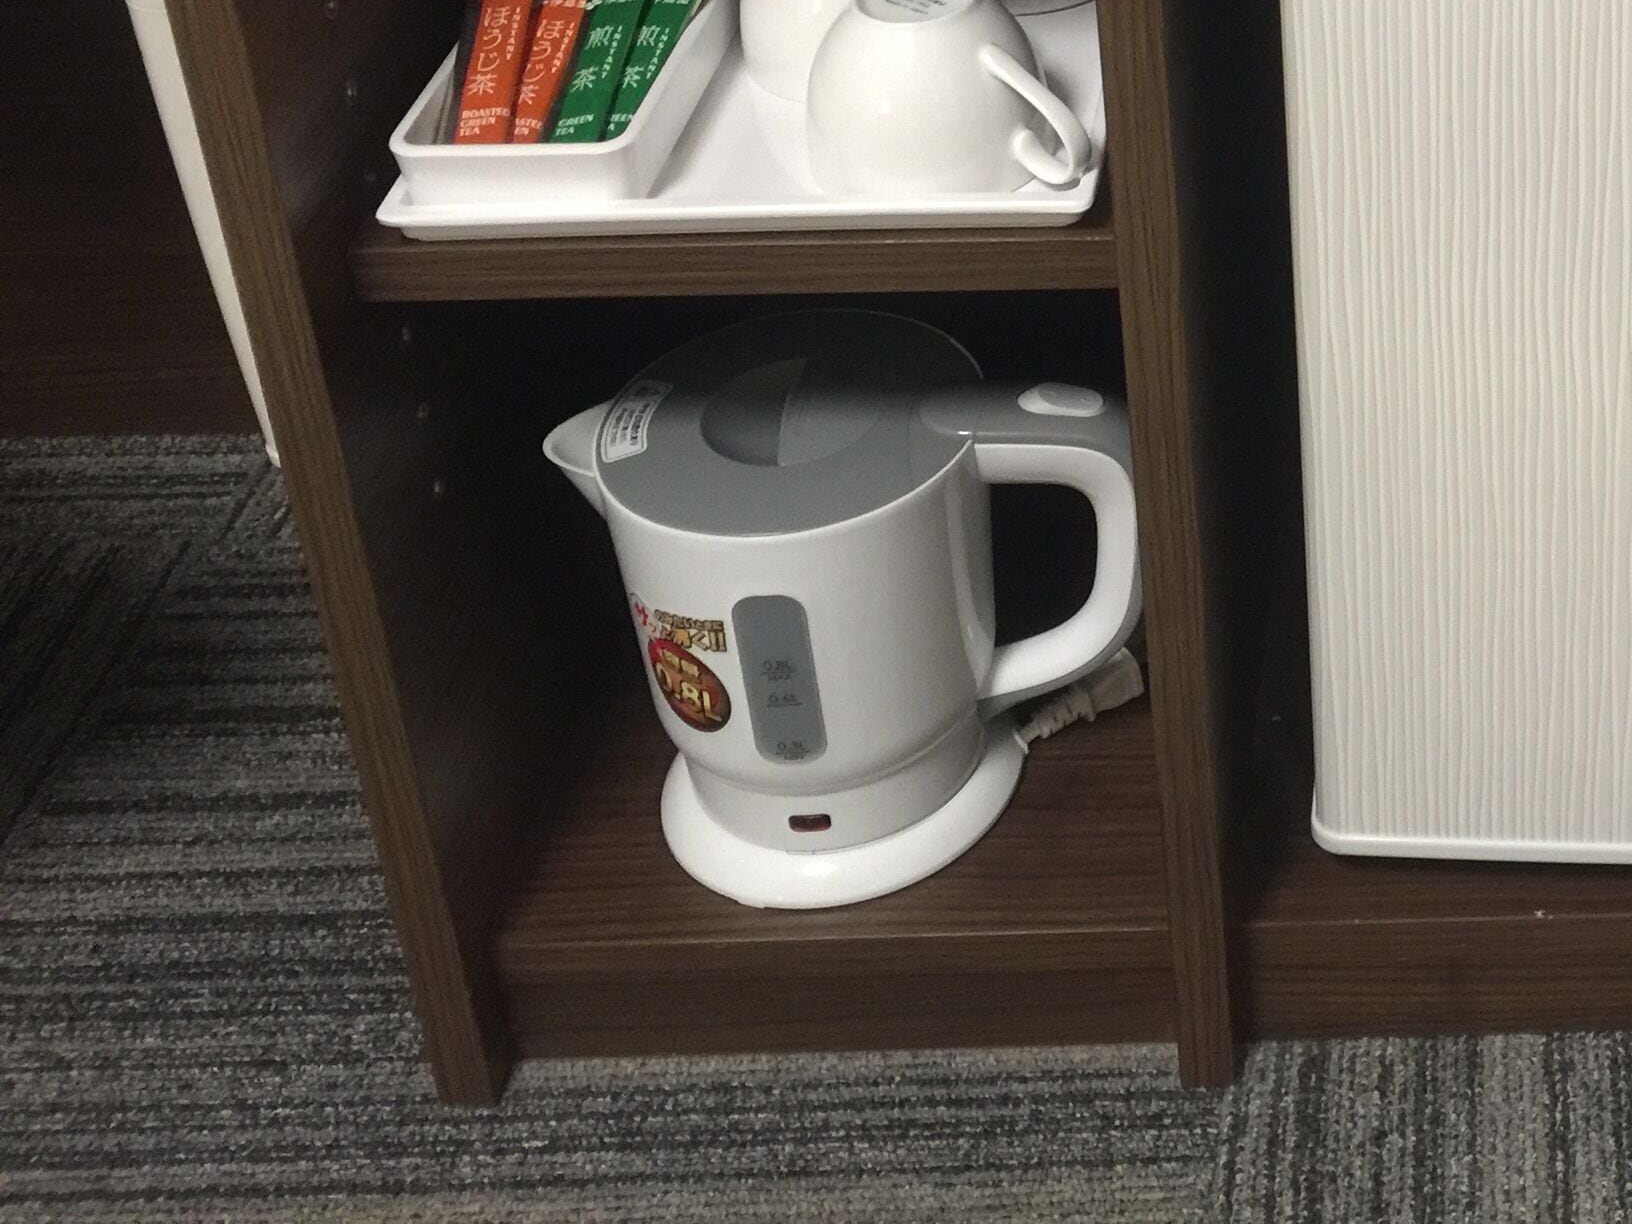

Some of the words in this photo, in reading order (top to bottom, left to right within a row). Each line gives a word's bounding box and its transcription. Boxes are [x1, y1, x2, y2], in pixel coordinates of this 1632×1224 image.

[467, 6, 511, 96] ほうじ茶
[505, 6, 522, 60] INSTANT
[551, 22, 575, 74] INSTANT
[570, 25, 615, 93] 煎茶
[601, 25, 623, 79] INSTANT
[646, 28, 670, 80] INSTANT
[459, 127, 481, 137] TEA
[460, 117, 497, 127] GREEN
[462, 107, 511, 120] ROASTED
[555, 127, 575, 137] TEA
[558, 114, 595, 127] GREEN
[656, 661, 723, 723] 0.8L
